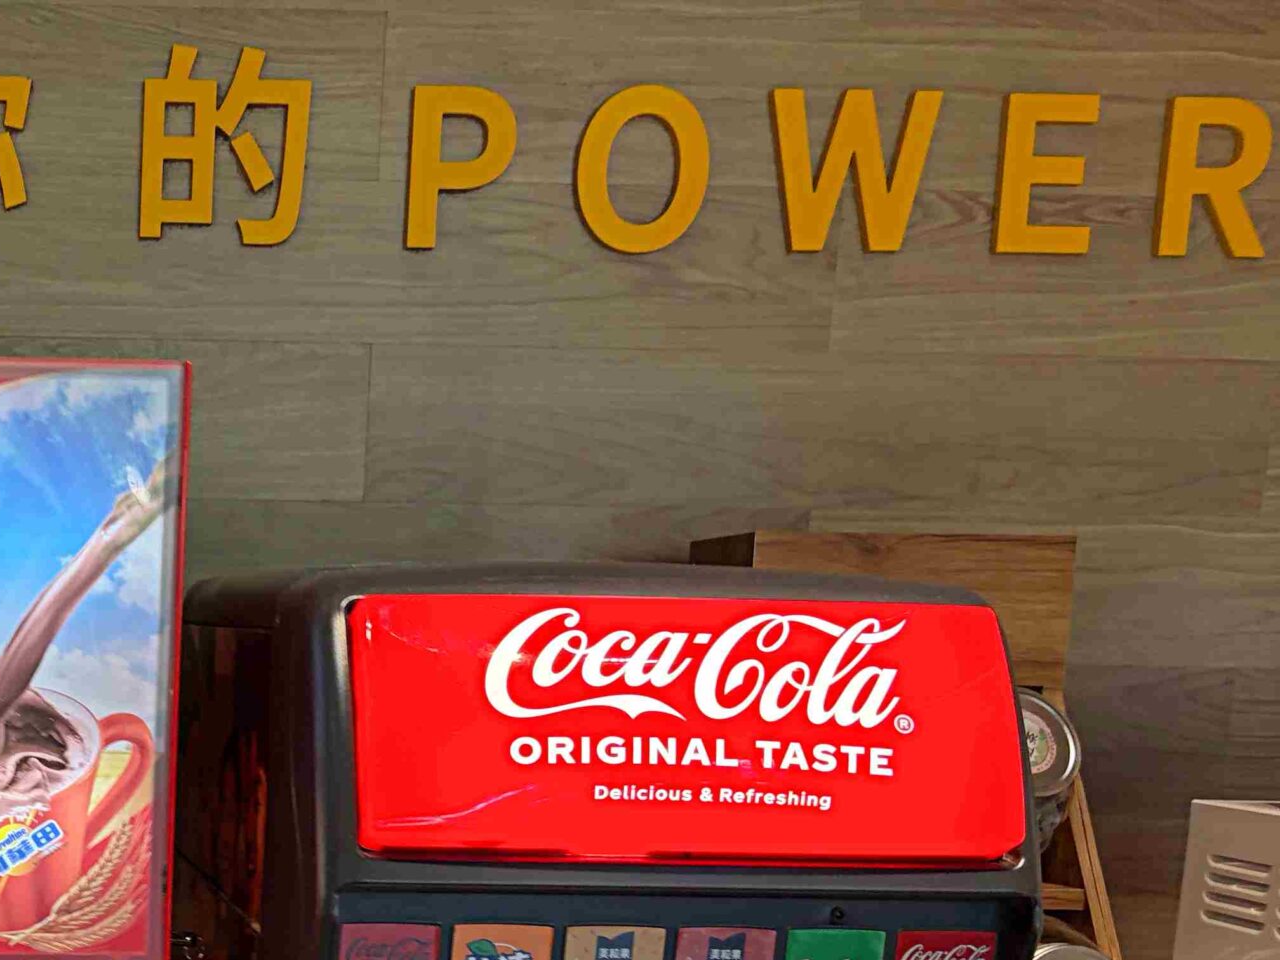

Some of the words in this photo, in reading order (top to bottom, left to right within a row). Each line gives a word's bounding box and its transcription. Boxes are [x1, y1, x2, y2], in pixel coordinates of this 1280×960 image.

[403, 84, 1273, 258] POWER
[484, 607, 907, 729] Coca-Cola
[509, 736, 739, 768] ORIGINAL
[755, 739, 895, 776] TASTE
[594, 785, 693, 803] Delicious
[699, 788, 714, 803] &
[719, 788, 832, 811] Refreshing
